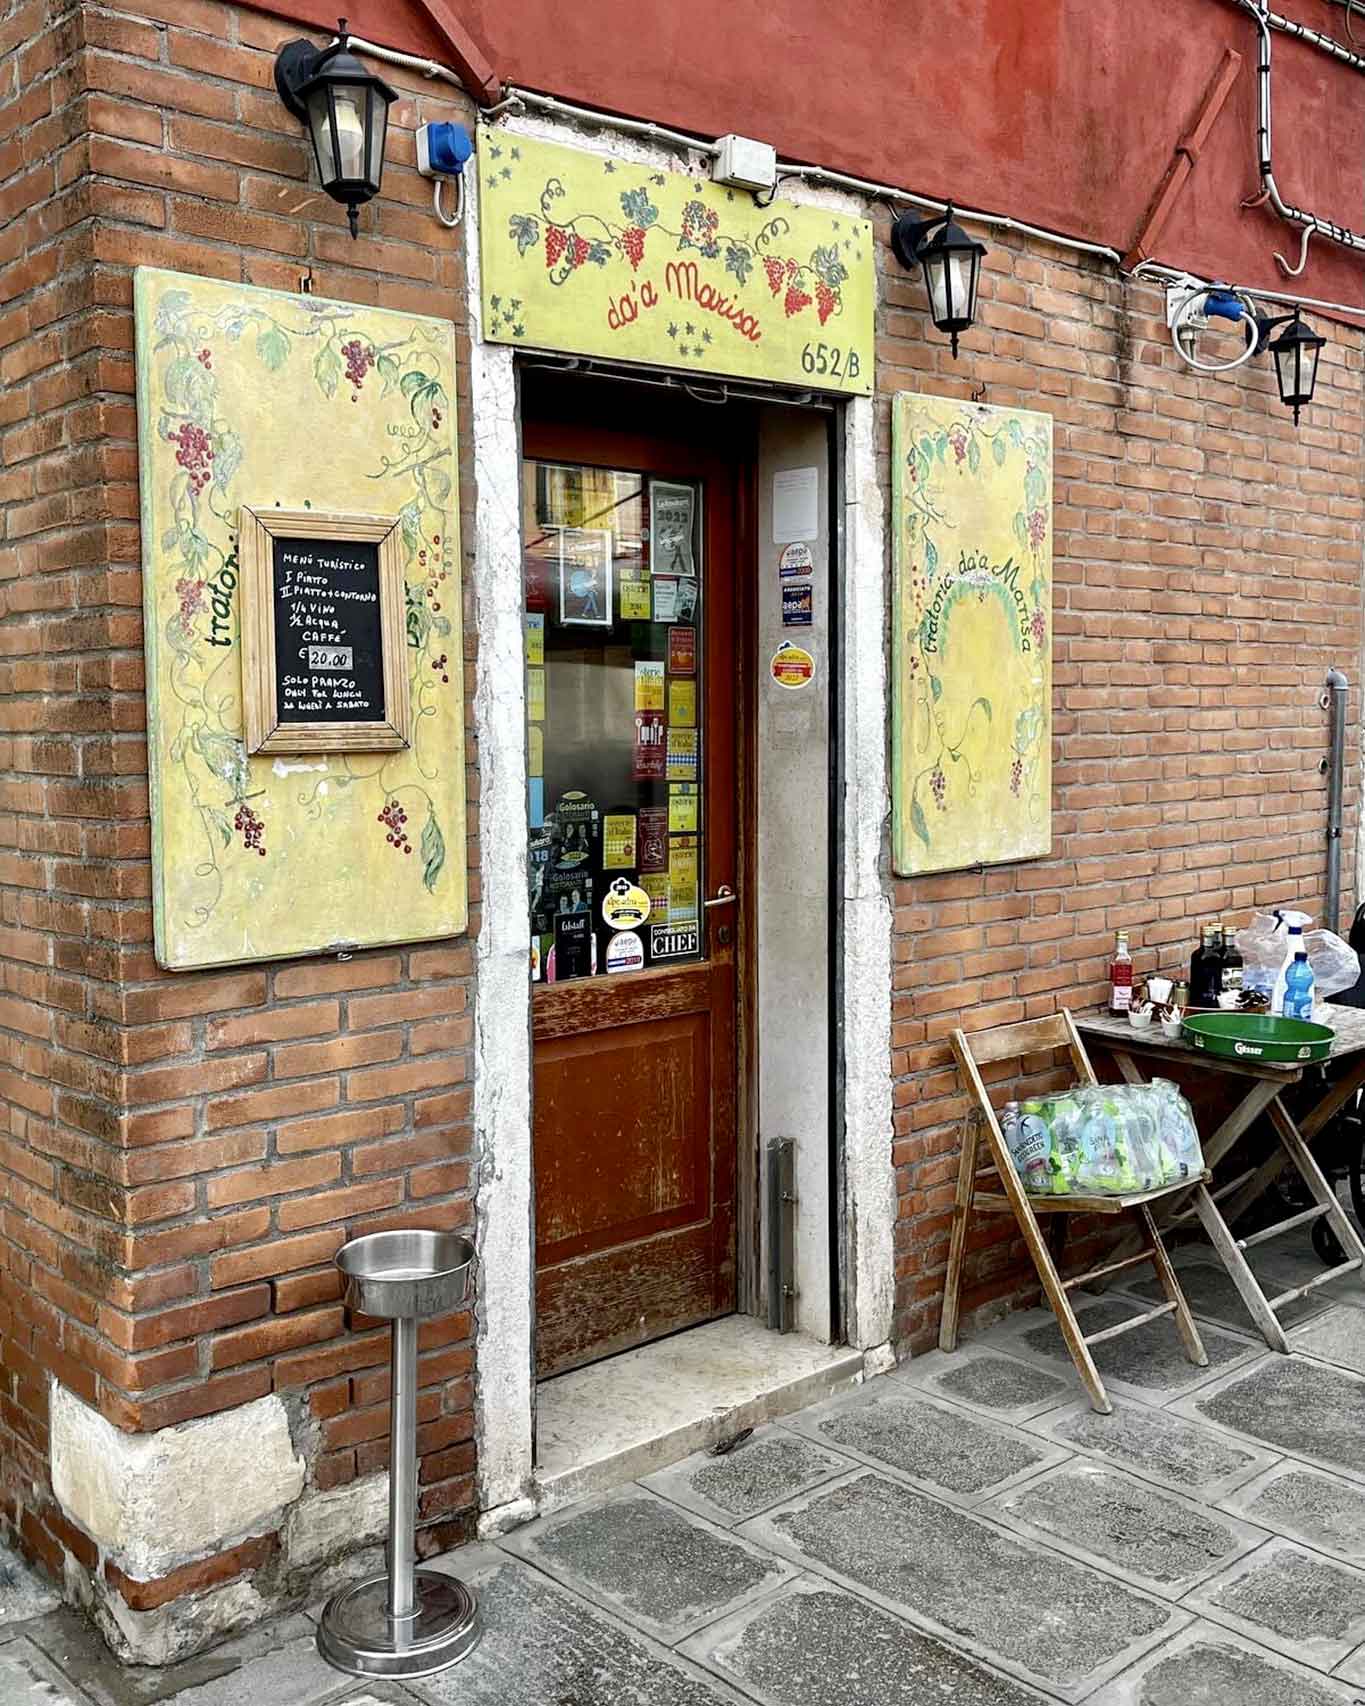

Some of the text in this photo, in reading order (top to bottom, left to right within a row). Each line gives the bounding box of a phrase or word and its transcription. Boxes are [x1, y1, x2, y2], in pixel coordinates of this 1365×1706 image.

[666, 261, 761, 342] Marisa
[801, 343, 861, 387] 652/B
[285, 570, 293, 583] I
[991, 557, 1032, 653] Marisa
[298, 648, 308, 659] €
[559, 801, 595, 812] Golosario
[653, 933, 697, 954] CHEF
